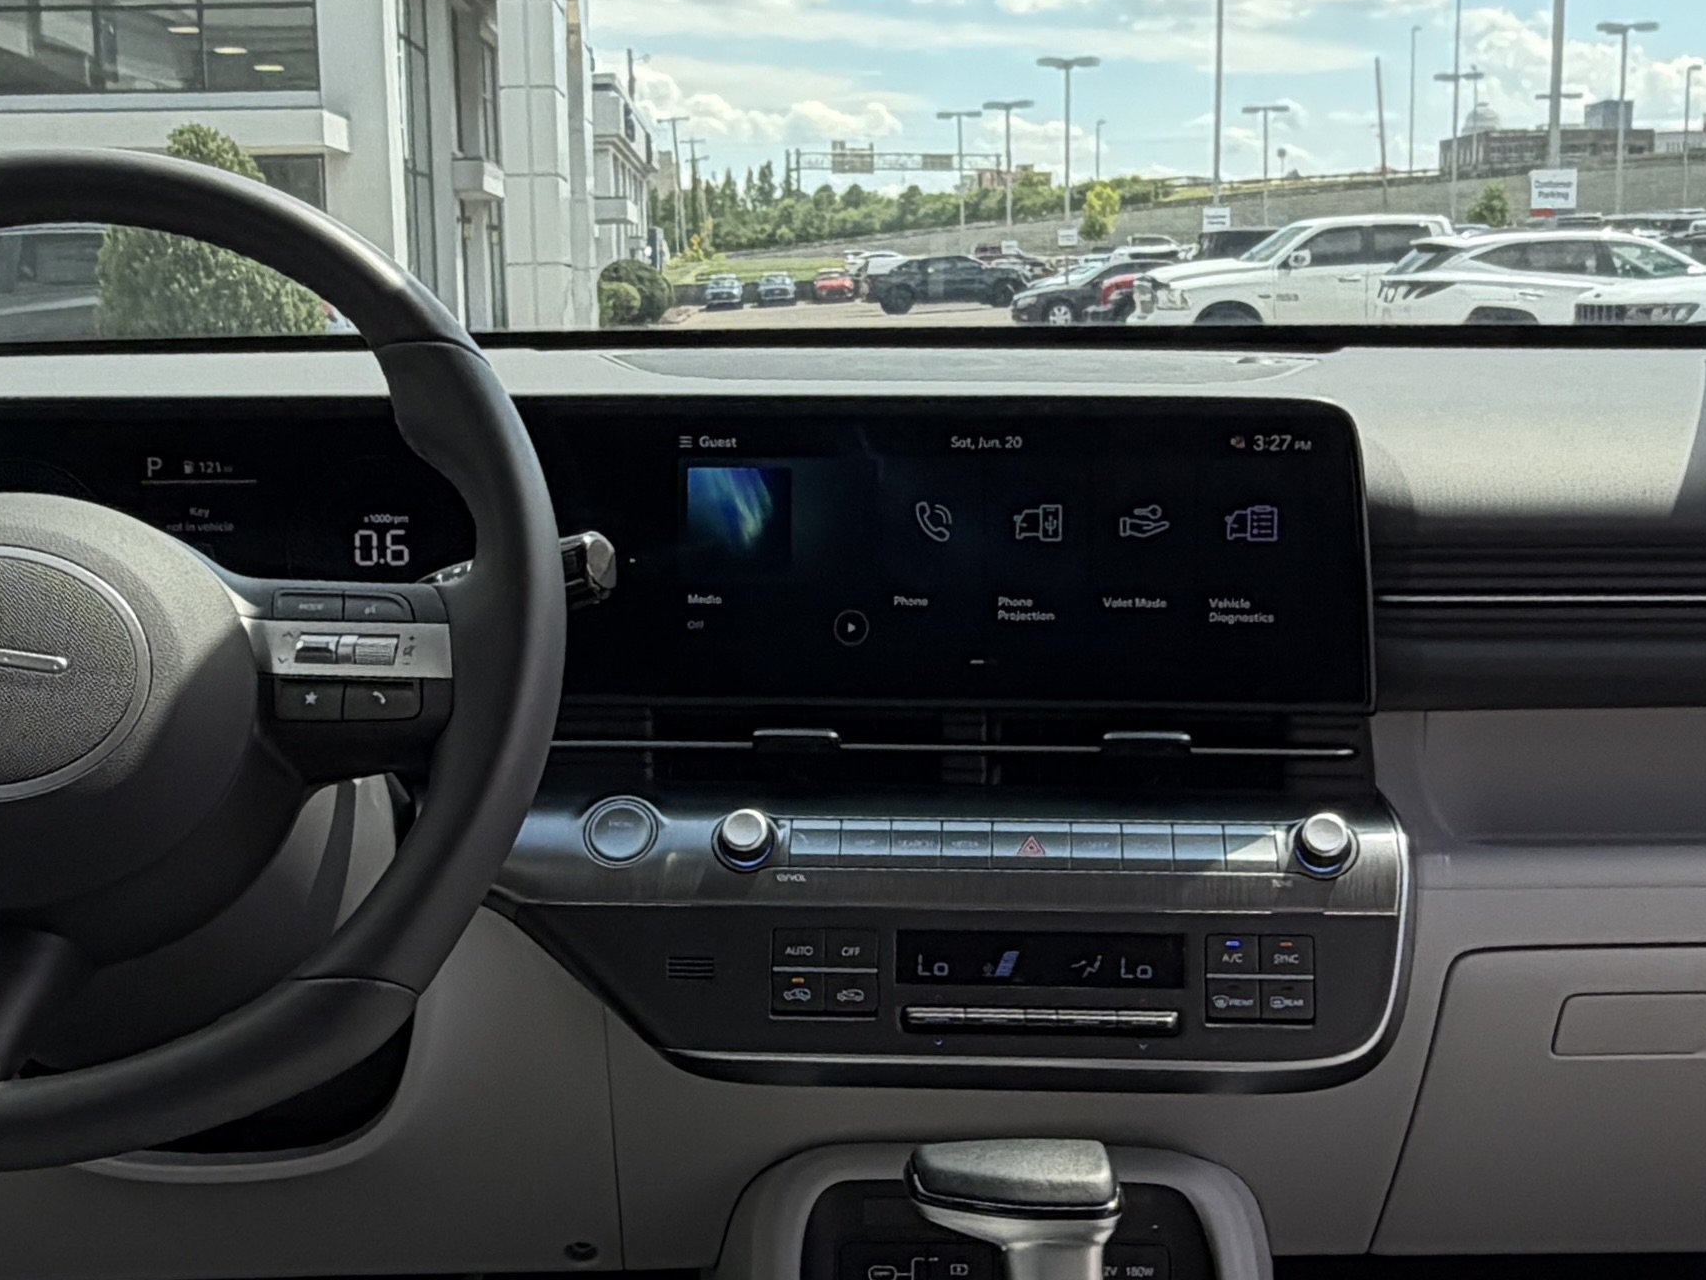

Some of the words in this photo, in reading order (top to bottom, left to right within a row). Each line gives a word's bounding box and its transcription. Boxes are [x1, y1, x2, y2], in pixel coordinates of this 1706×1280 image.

[698, 435, 738, 449] Guest
[1004, 435, 1023, 449] 20
[1252, 434, 1293, 452] 3:27
[146, 456, 163, 477] P
[198, 461, 222, 474] 121
[189, 506, 211, 519] Key
[197, 521, 235, 533] vehicle
[353, 528, 410, 567] 0.6
[687, 593, 723, 605] Media
[892, 595, 929, 607] Phone
[997, 595, 1033, 607] Phone
[1208, 597, 1251, 609] Vehicle
[997, 609, 1056, 622] Projection
[1208, 611, 1275, 625] Diagnostics
[784, 946, 814, 956] AUTO
[841, 946, 861, 957] OFF
[917, 953, 949, 976] Lo
[1221, 953, 1244, 963] A/C
[1273, 953, 1300, 965] SYNC
[1120, 956, 1153, 979] Lo
